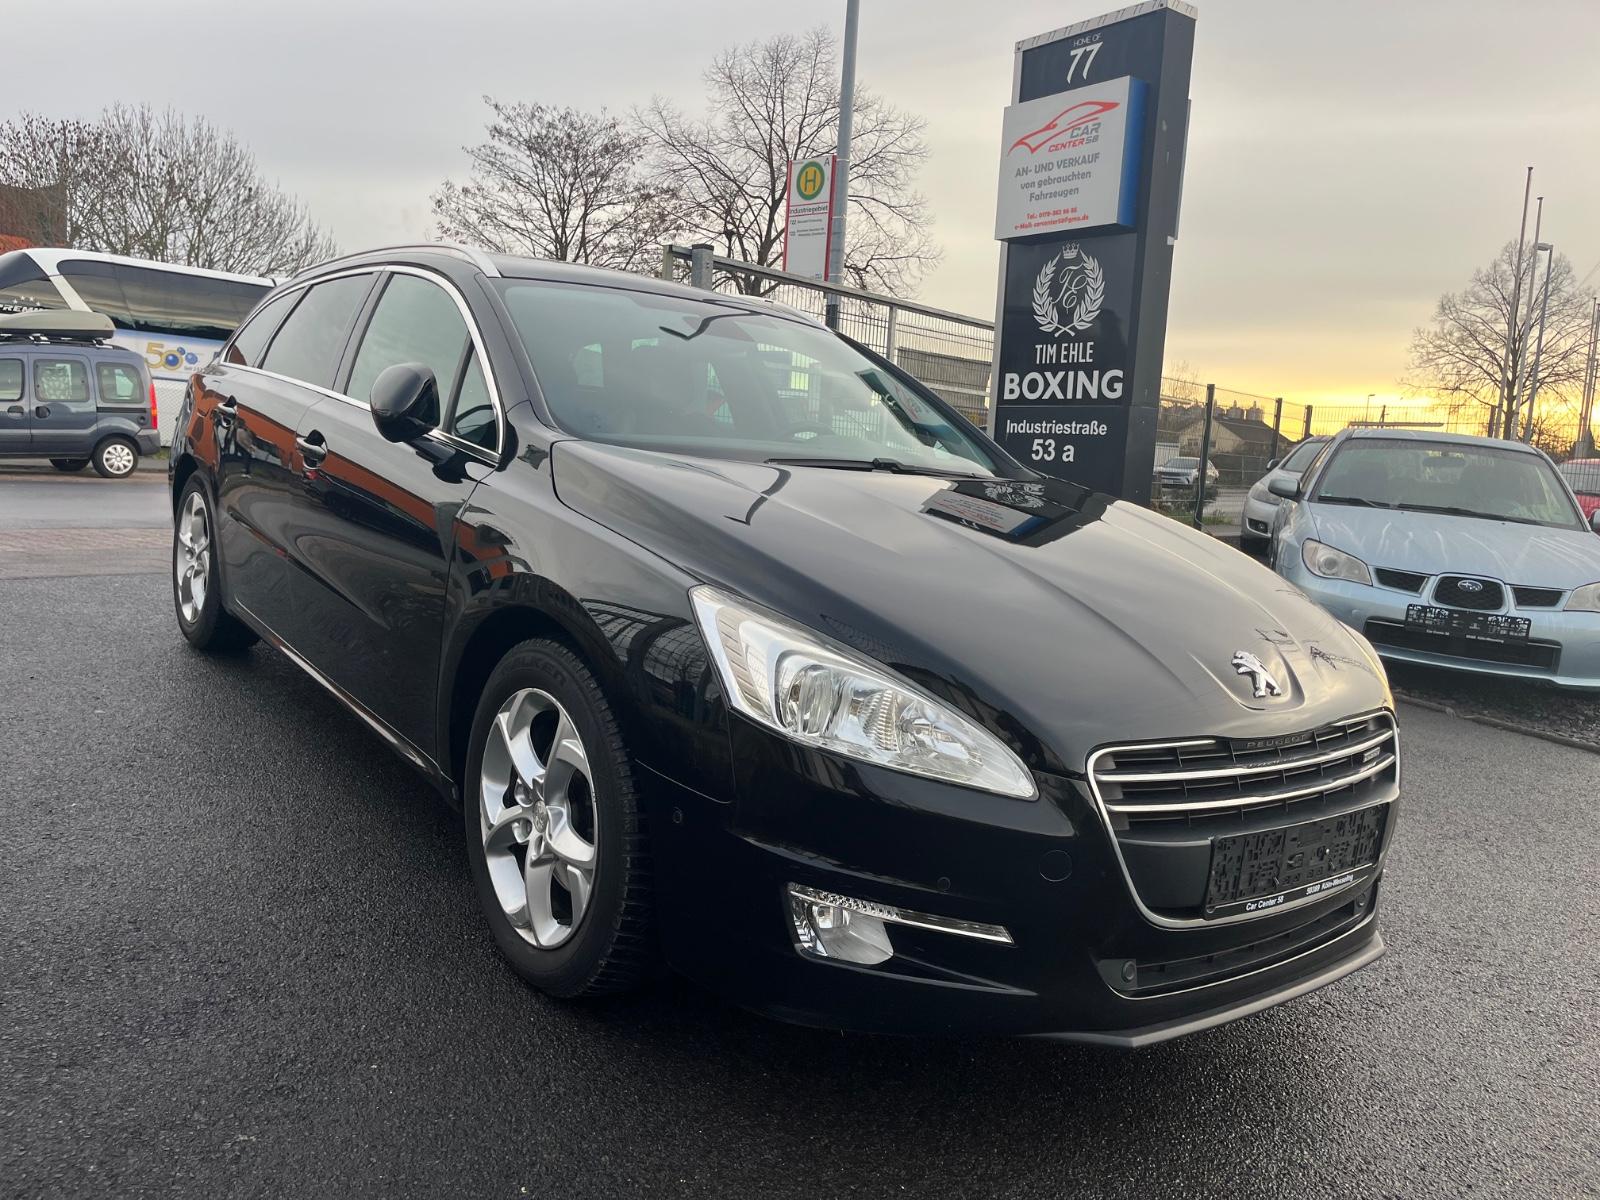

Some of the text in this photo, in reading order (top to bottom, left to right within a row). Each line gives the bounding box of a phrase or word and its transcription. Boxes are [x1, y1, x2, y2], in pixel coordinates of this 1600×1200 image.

[1073, 32, 1102, 47] HOME OF
[1066, 41, 1103, 84] 77
[1069, 122, 1101, 139] CAR
[1014, 152, 1100, 178] AN- UND VERKAUF
[1020, 170, 1092, 190] von gebrauchten
[1029, 187, 1079, 202] Fahrzeugen
[1035, 341, 1094, 365] TIM EHLE
[1003, 368, 1124, 400] BOXING
[1006, 419, 1108, 437] Industriestraße
[1031, 438, 1075, 462] 53 a
[1246, 734, 1306, 749] PEUGEOT
[1246, 902, 1257, 911] Car
[1258, 898, 1277, 909] Center
